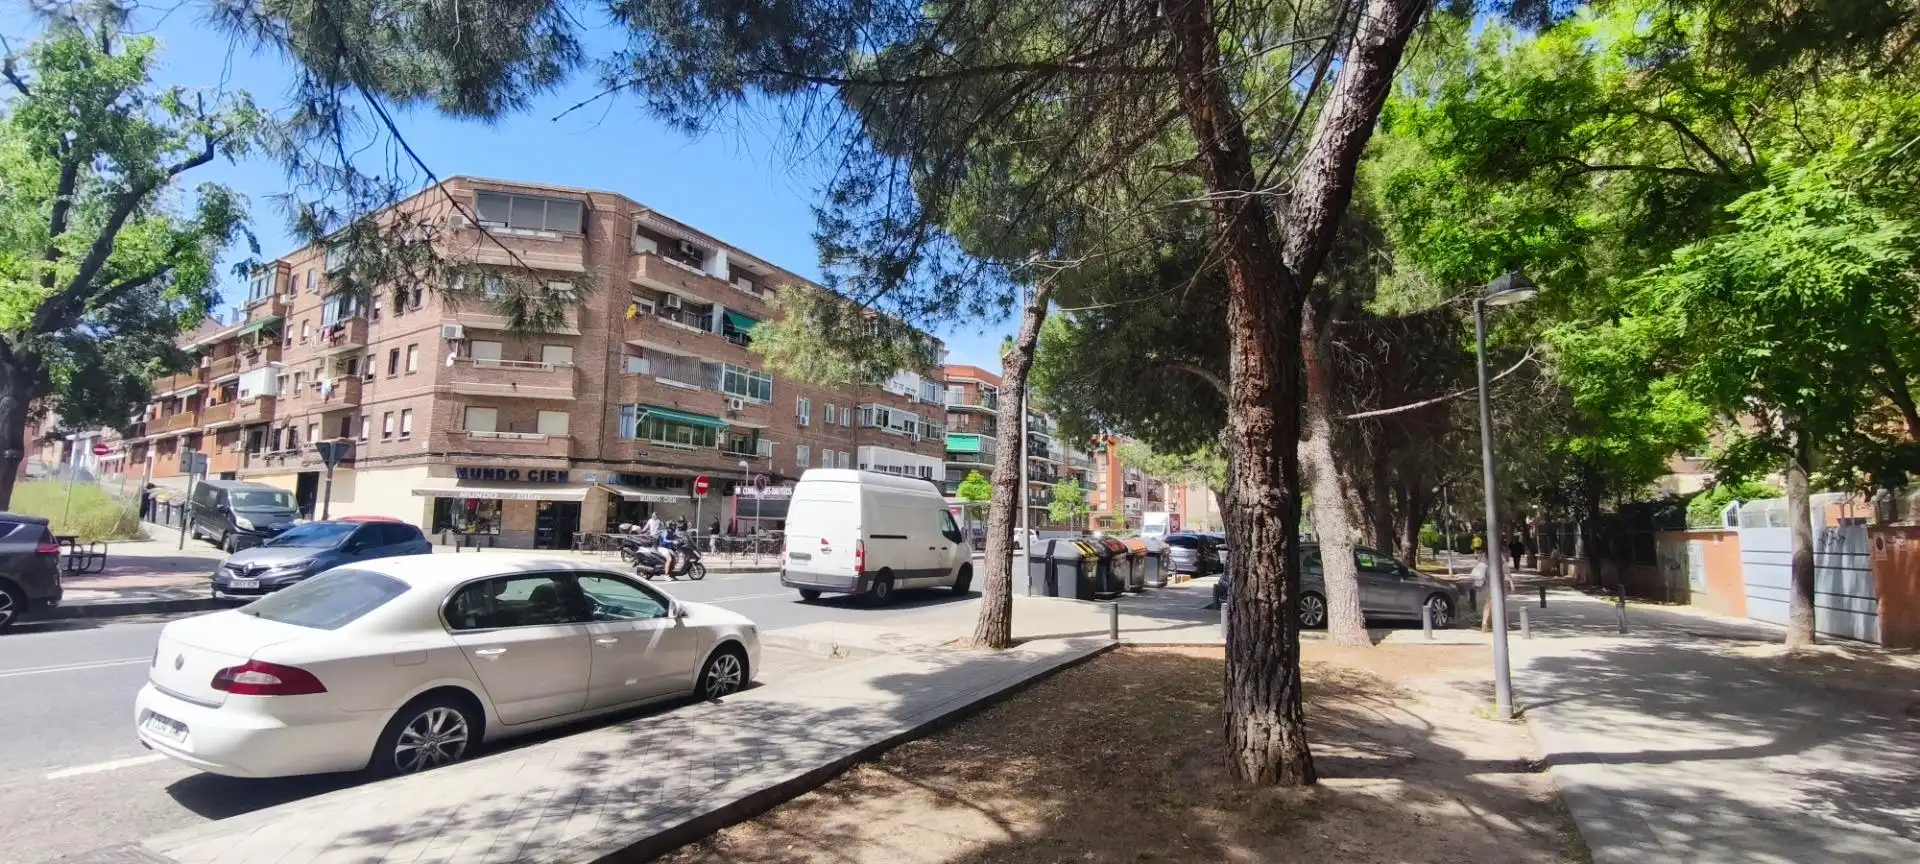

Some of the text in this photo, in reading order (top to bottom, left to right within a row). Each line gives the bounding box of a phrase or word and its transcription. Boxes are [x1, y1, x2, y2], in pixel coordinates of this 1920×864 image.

[456, 467, 569, 483] MUNDO CIEN
[459, 491, 497, 499] MUNDO
